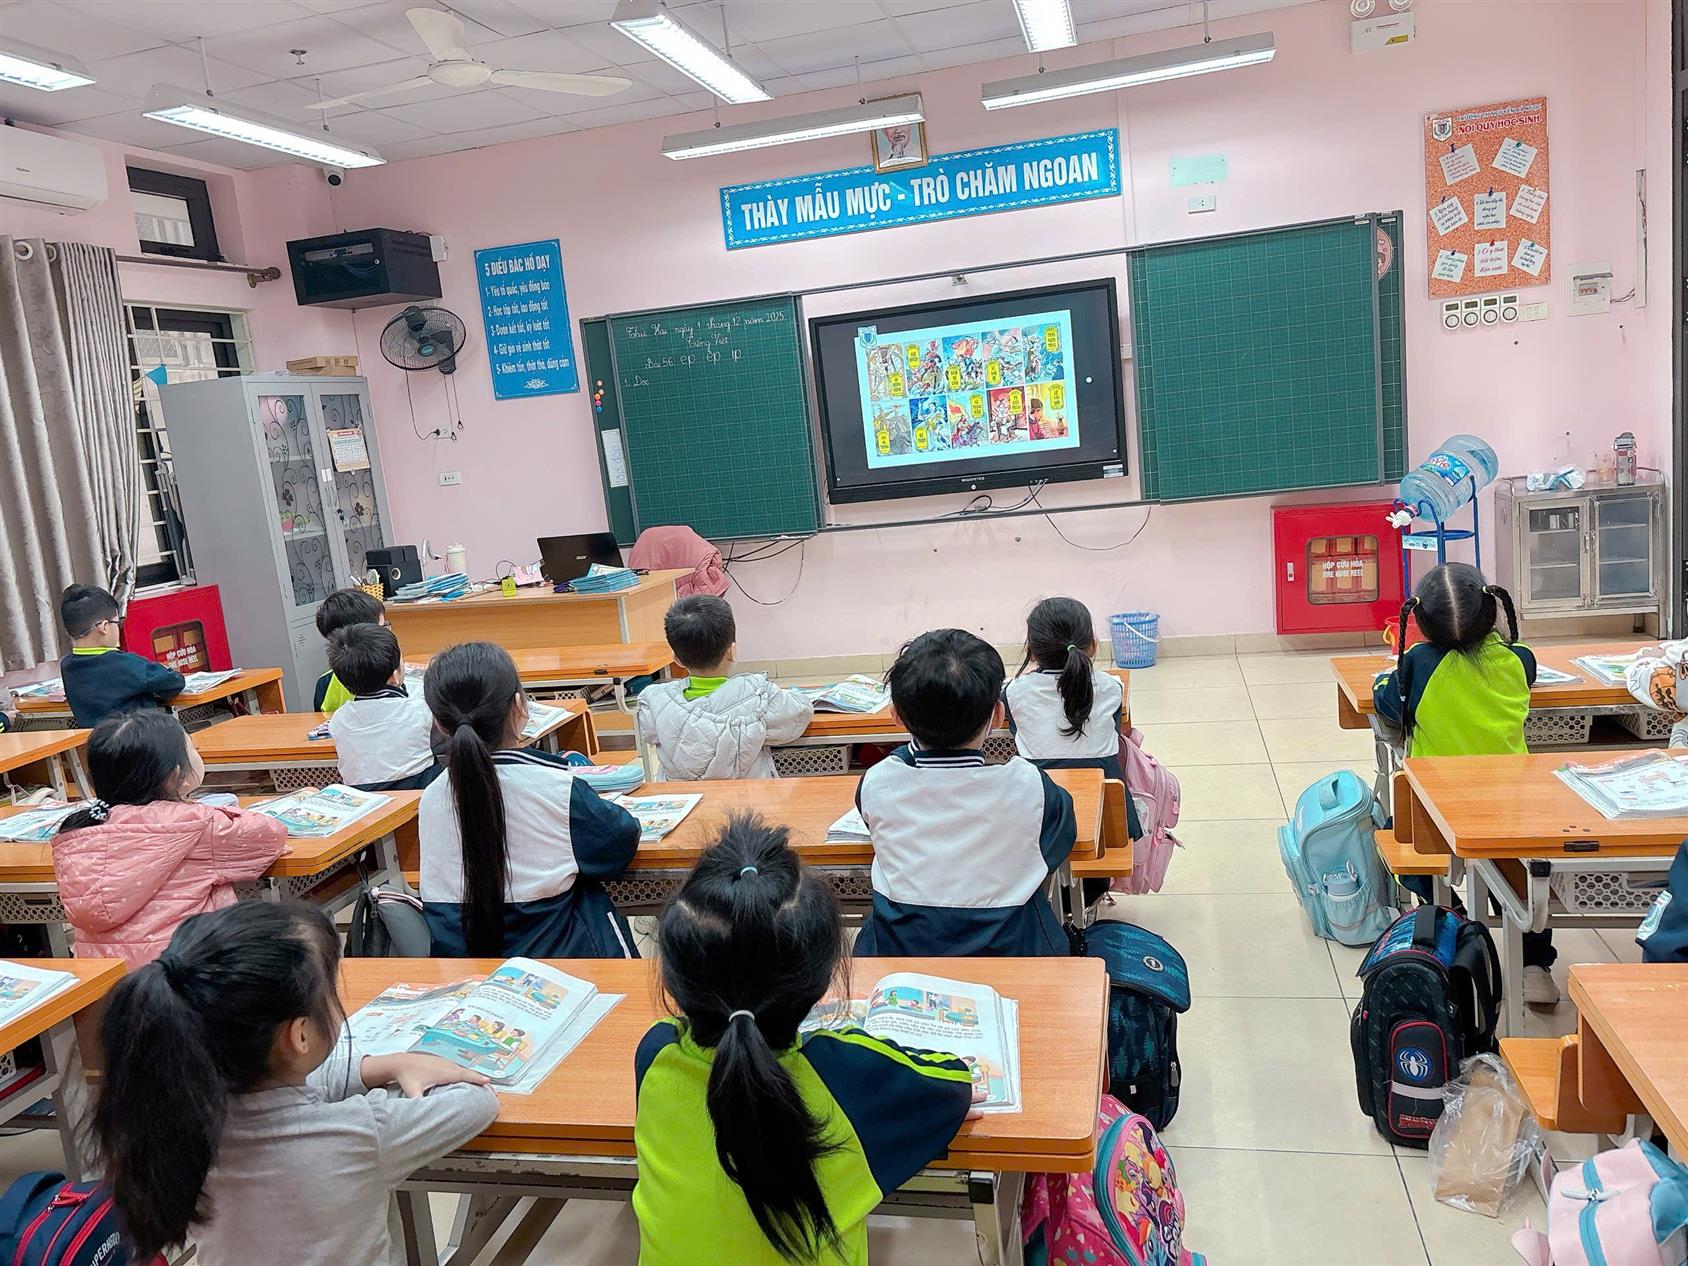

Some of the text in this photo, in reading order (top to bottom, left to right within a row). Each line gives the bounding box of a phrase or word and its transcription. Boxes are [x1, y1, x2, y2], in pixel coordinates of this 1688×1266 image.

[1518, 114, 1541, 124] SINH
[741, 195, 789, 231] THÀY
[795, 182, 841, 223] MẪU
[845, 182, 892, 219] MỰC
[910, 168, 950, 207] TRÒ
[955, 161, 1018, 201] CHĂM
[1023, 152, 1099, 191] NGOAN
[484, 263, 490, 277] 5
[508, 256, 523, 273] BÁC
[535, 254, 550, 272] DẠY
[674, 325, 693, 339] ngày
[732, 316, 741, 326] 12
[765, 311, 785, 323] 2025
[680, 354, 696, 369] ep
[1322, 560, 1335, 571] HỘP
